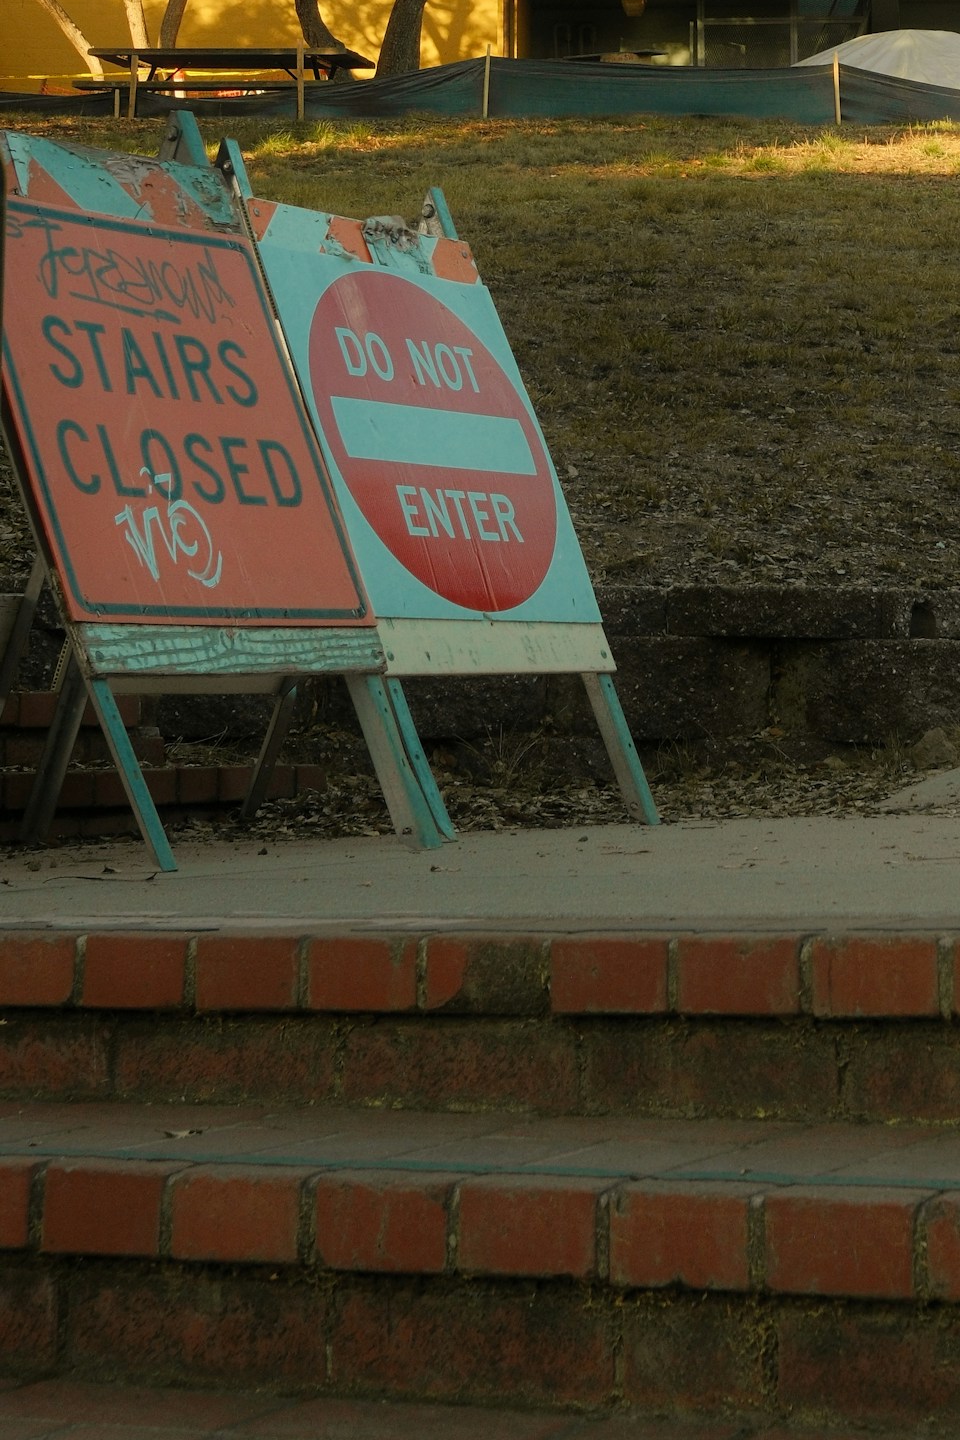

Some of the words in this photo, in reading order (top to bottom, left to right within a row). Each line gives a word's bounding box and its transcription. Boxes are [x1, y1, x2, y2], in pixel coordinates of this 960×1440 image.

[41, 315, 258, 408] STAIRS
[334, 327, 394, 381] DO
[405, 338, 480, 393] NOT
[56, 419, 303, 507] CLOSED
[396, 485, 525, 543] ENTER
